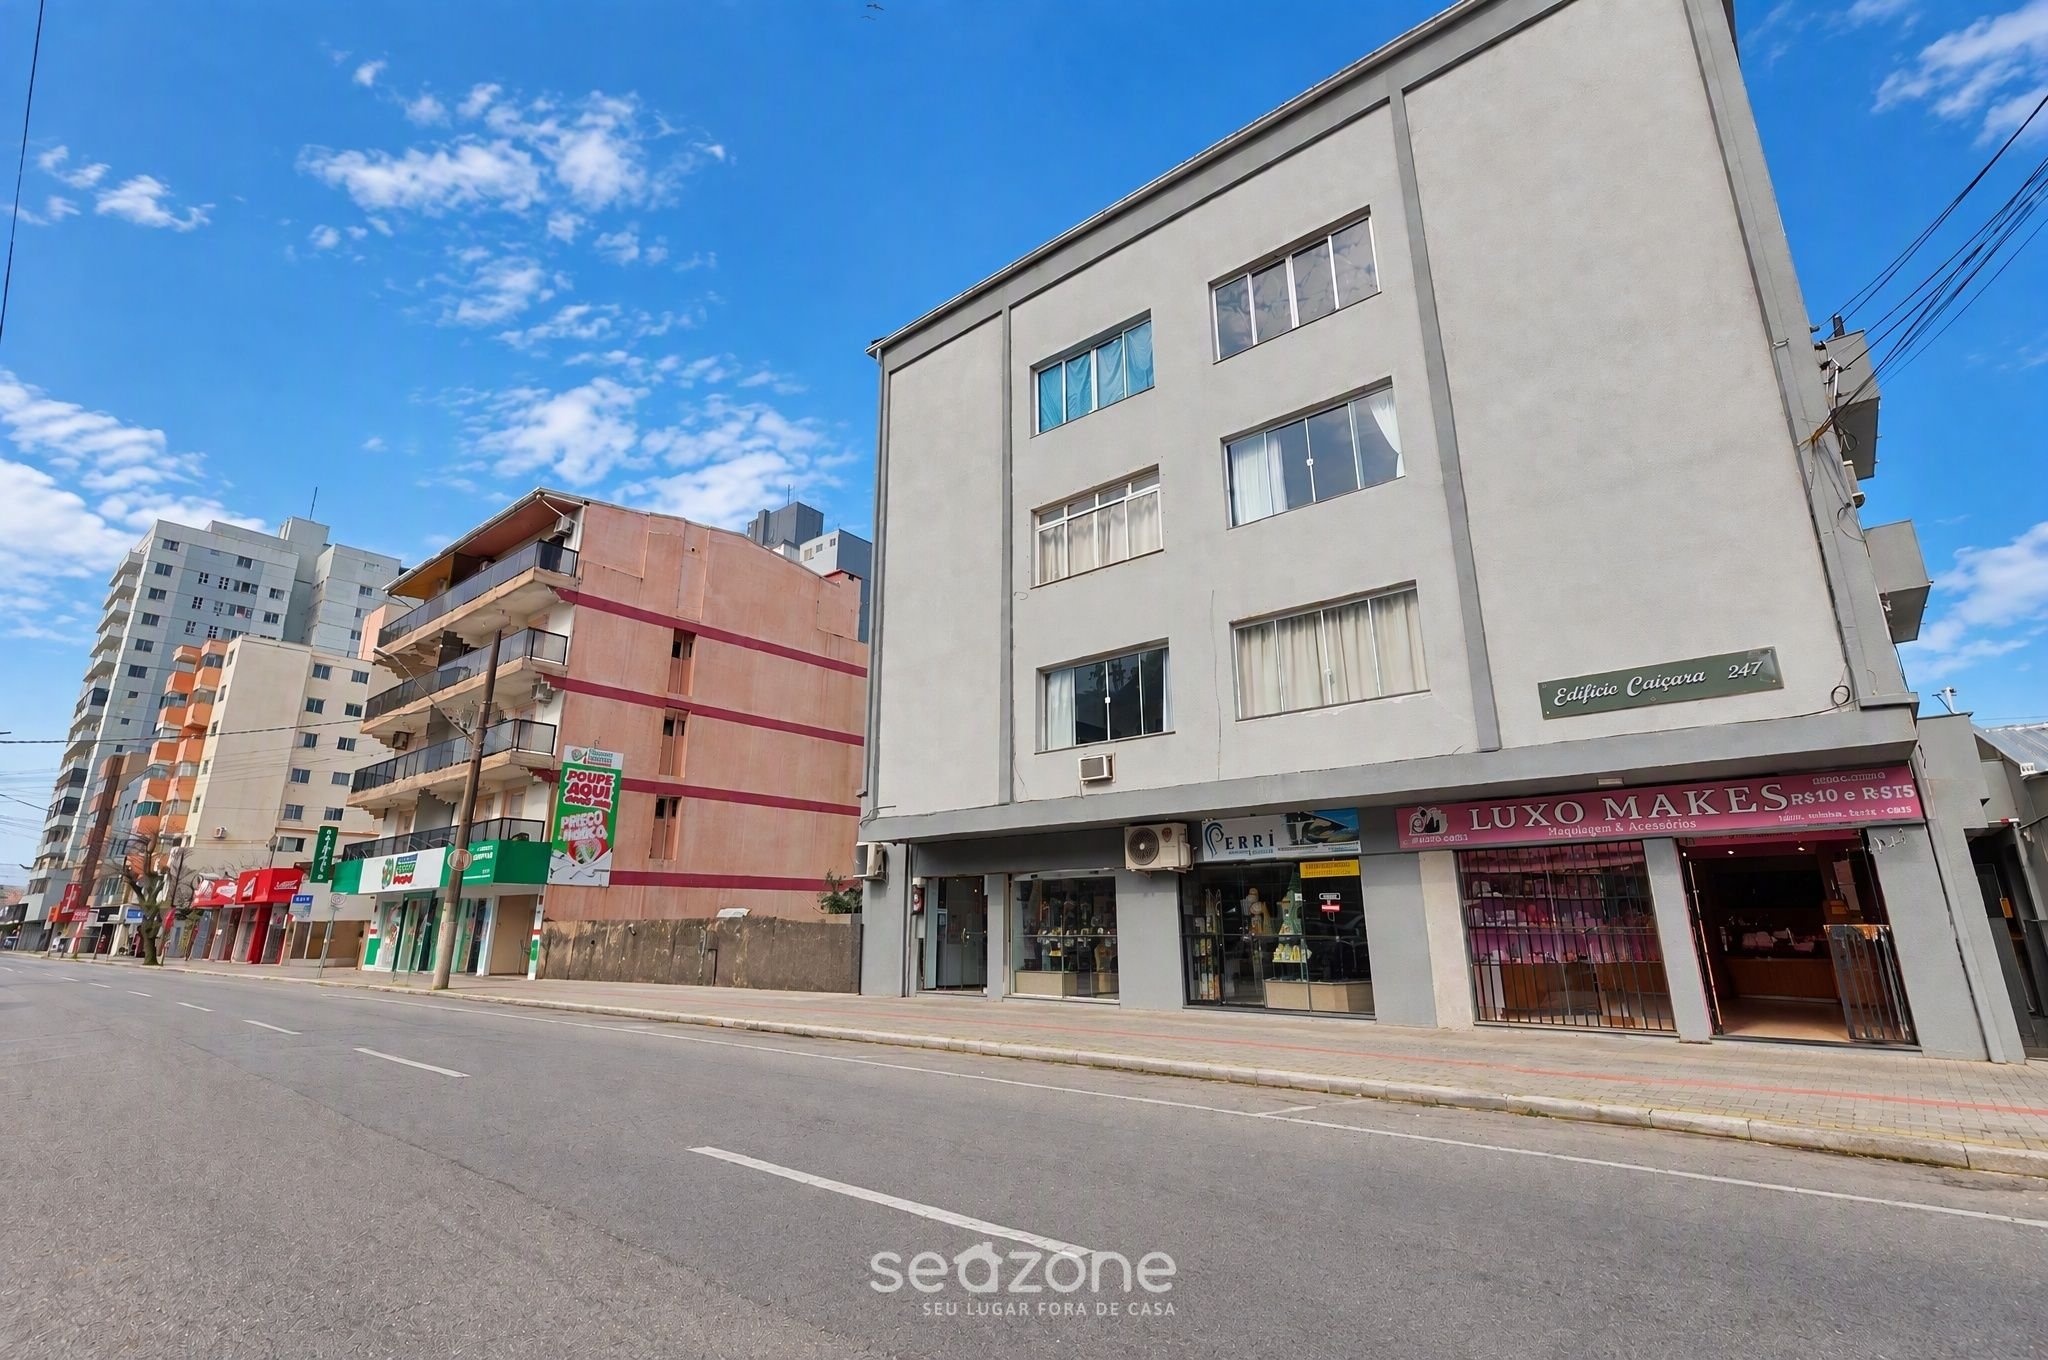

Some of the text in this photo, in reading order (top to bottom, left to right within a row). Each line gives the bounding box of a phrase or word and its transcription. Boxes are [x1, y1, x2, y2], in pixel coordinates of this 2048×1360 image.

[1627, 670, 1706, 697] Caiçara
[1727, 661, 1764, 680] 247
[566, 770, 614, 786] POUPE
[566, 782, 611, 799] AQUI
[1791, 789, 1838, 805] R$10
[1844, 791, 1856, 801] e
[1468, 801, 1585, 831] LUXO
[1602, 783, 1789, 822] MAKES
[1615, 822, 1624, 832] &
